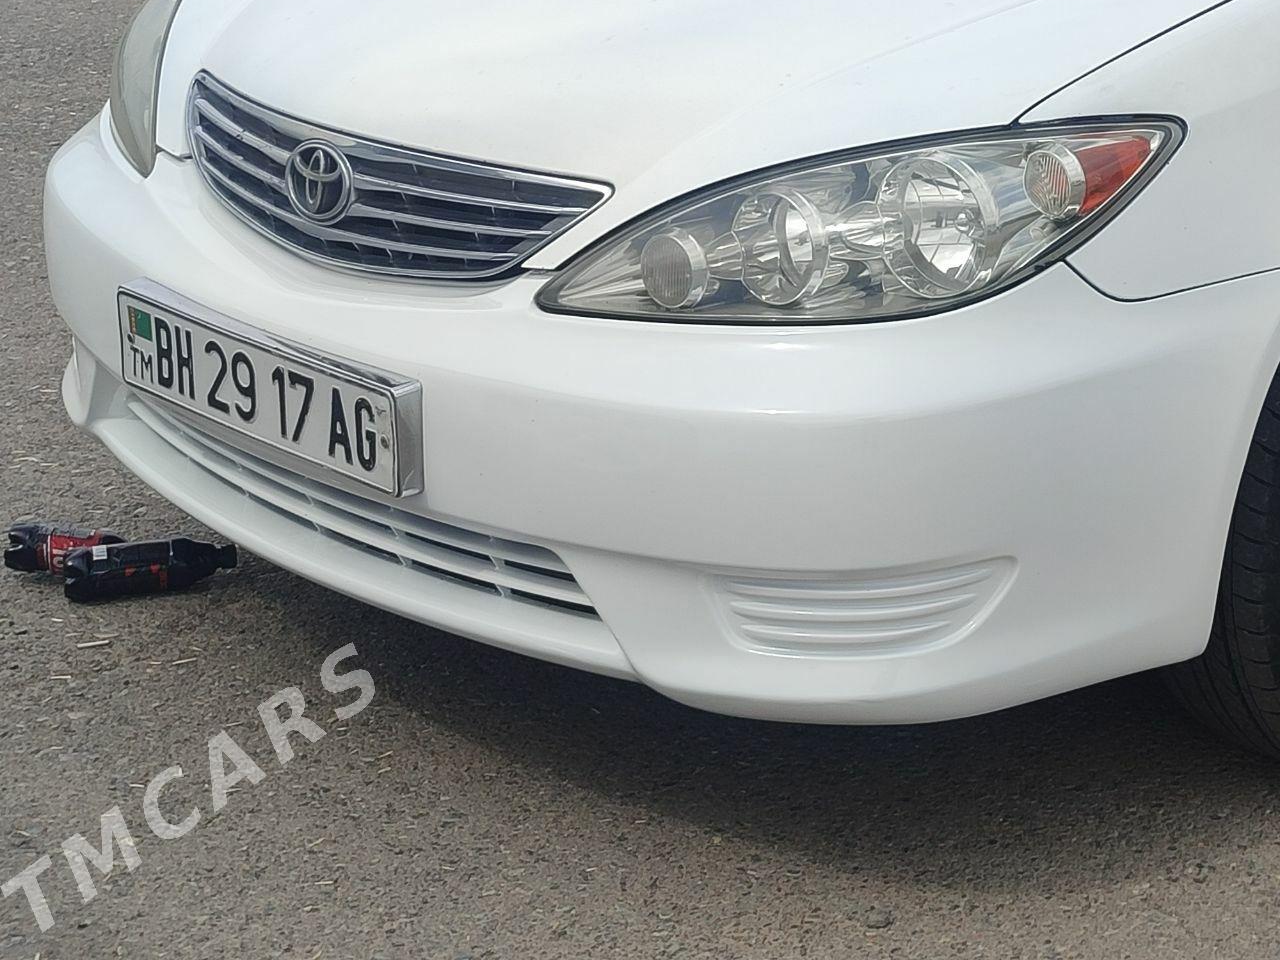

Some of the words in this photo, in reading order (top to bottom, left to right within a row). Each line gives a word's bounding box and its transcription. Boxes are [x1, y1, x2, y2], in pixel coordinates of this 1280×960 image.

[130, 345, 153, 384] TM
[154, 316, 196, 401] BH
[204, 340, 258, 423] 29
[272, 366, 315, 442] 17
[328, 386, 378, 472] AG
